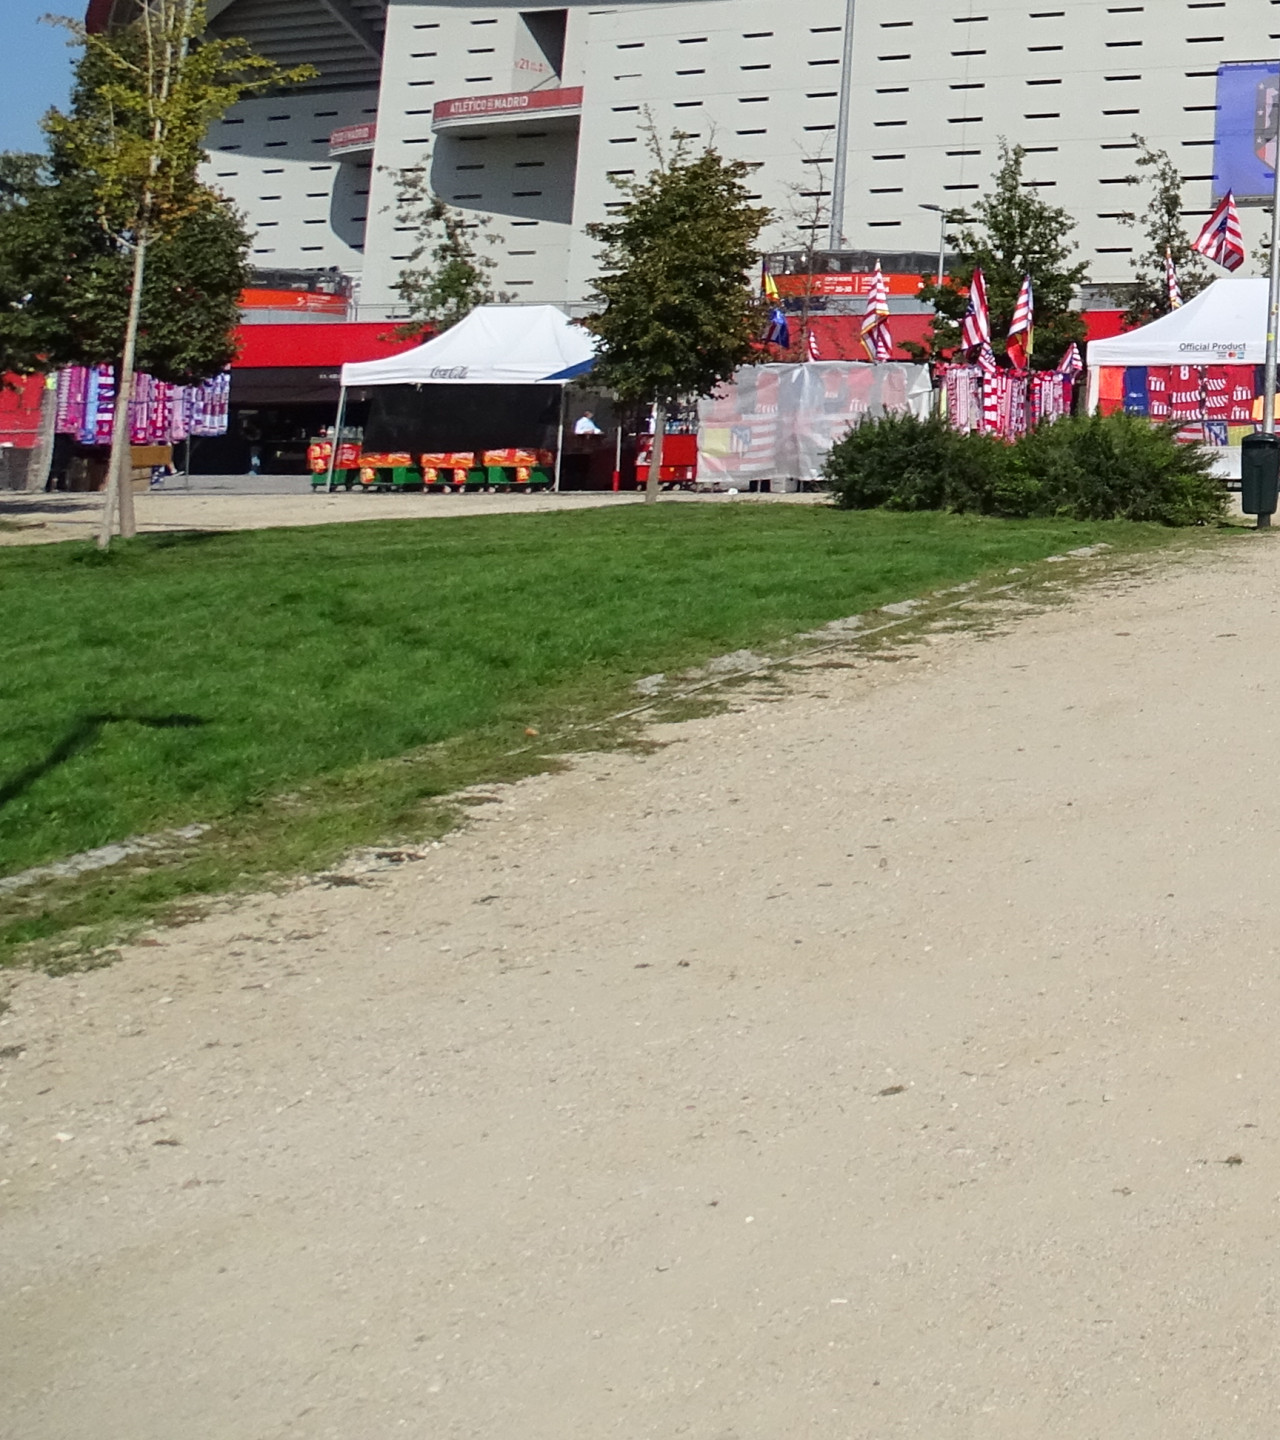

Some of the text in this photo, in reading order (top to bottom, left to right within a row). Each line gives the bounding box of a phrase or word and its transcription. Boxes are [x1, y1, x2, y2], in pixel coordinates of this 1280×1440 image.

[494, 96, 529, 109] MADRID
[1179, 342, 1247, 351] Official Product
